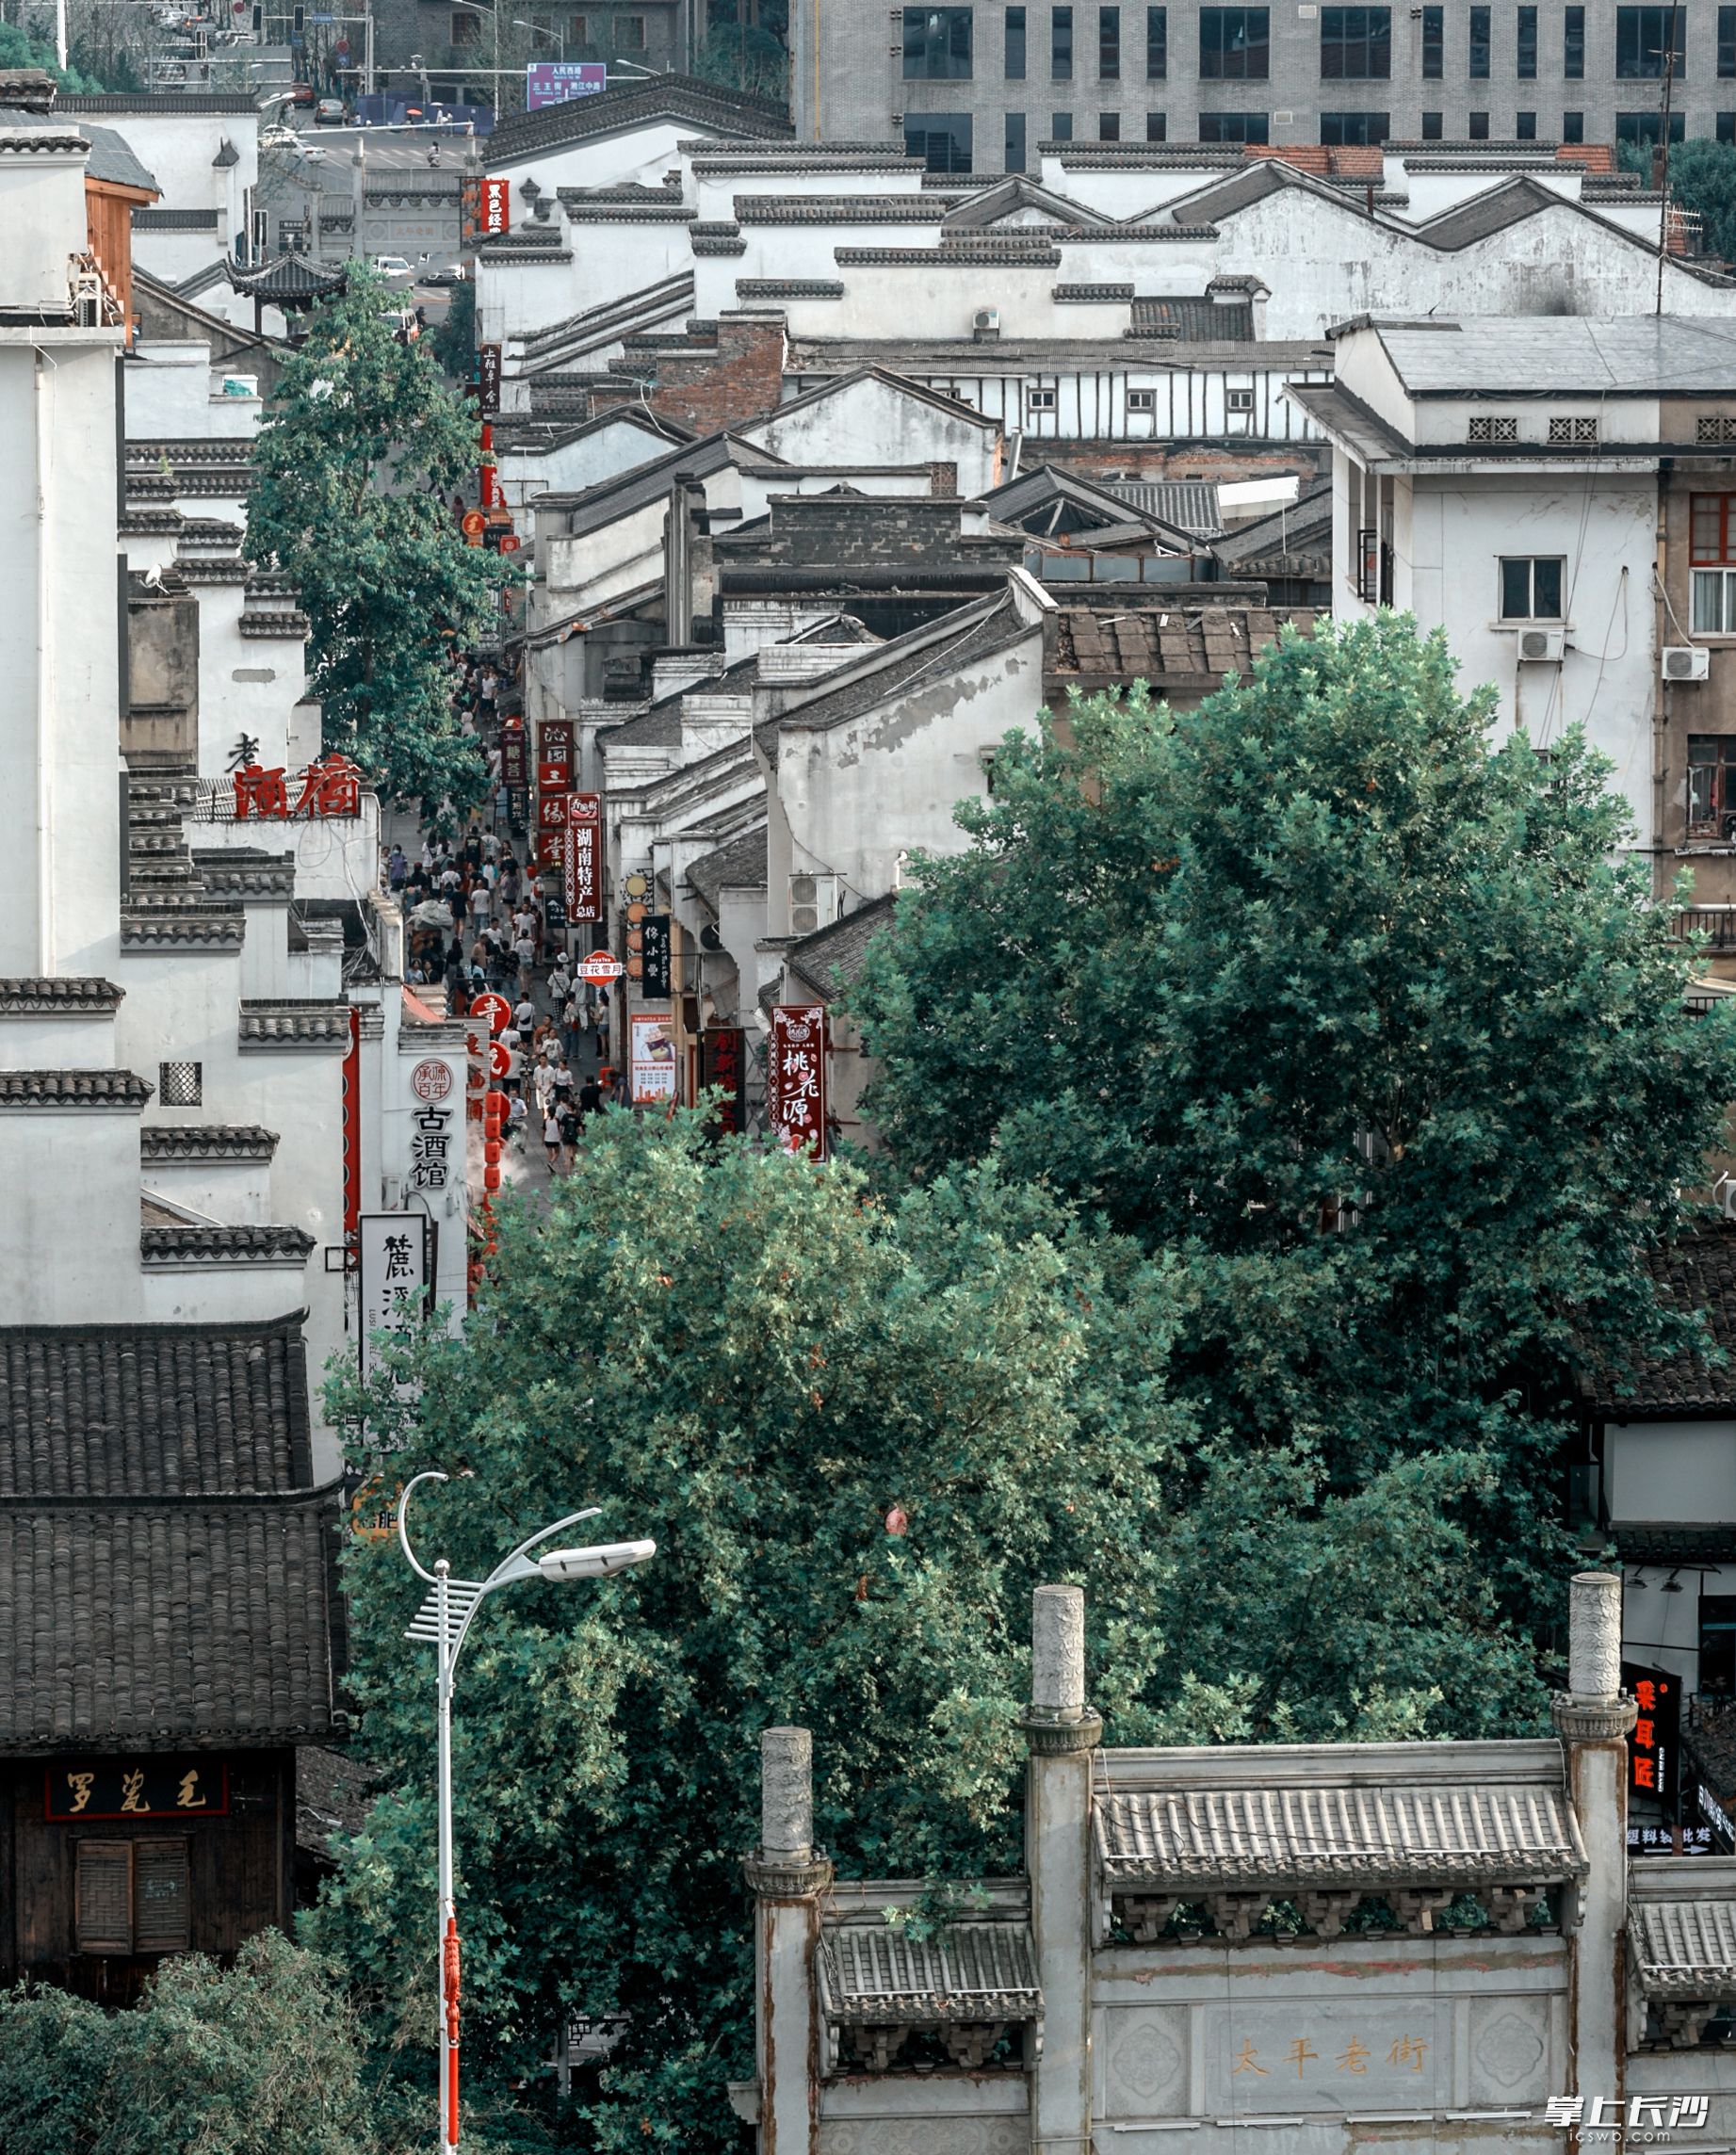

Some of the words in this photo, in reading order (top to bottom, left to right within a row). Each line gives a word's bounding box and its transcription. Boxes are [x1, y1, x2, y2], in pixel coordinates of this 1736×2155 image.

[552, 66, 581, 75] 人民西路
[576, 829, 593, 904] 湖南特产
[576, 906, 595, 917] 总店
[579, 964, 622, 975] 豆花雪月
[781, 1050, 819, 1127] 桃花源
[411, 1105, 451, 1188] 古酒馆
[1231, 2034, 1428, 2080] 太平老街
